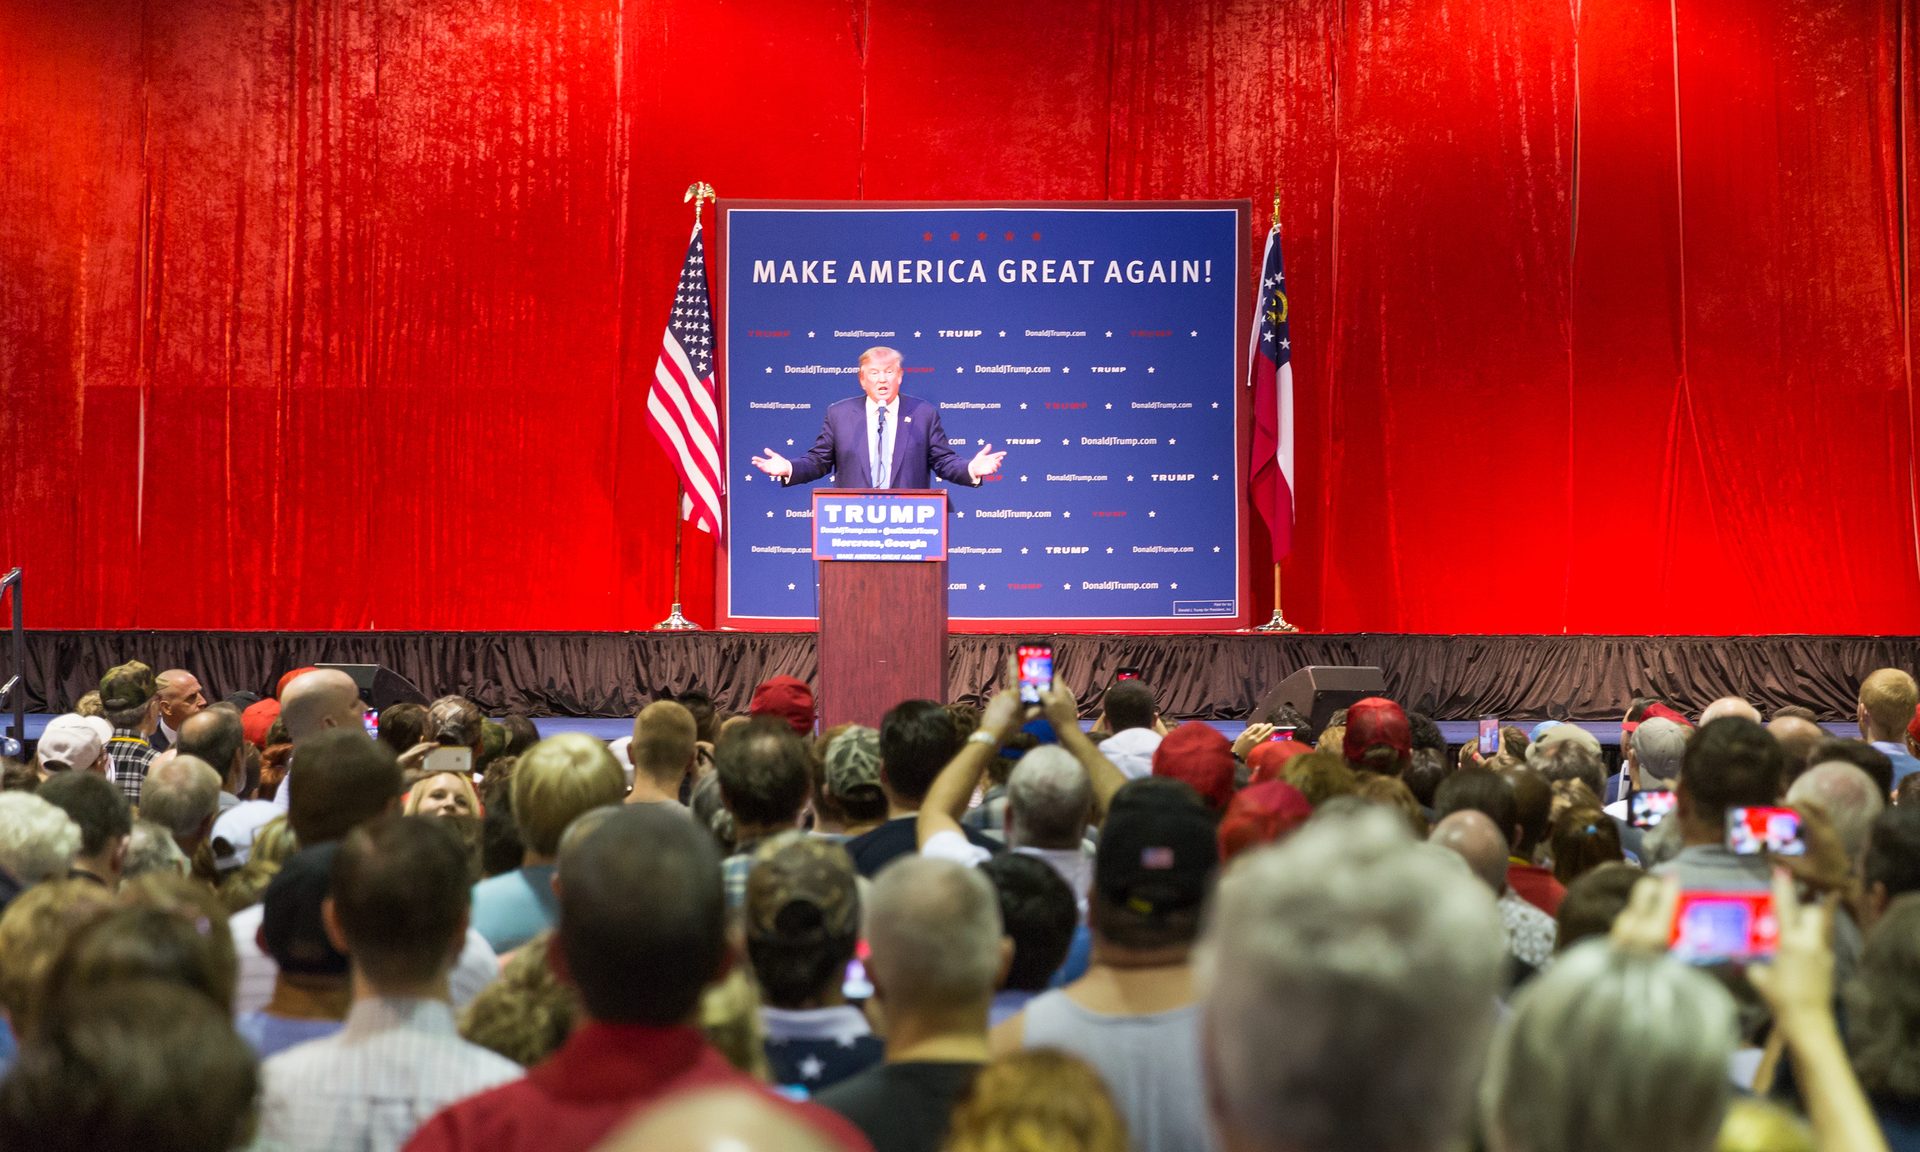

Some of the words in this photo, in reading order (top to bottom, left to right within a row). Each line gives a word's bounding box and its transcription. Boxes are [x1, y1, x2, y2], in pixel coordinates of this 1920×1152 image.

[753, 260, 836, 283] MAKE
[847, 260, 986, 283] AMERICA
[998, 260, 1094, 283] GREAT
[1104, 260, 1211, 283] AGAIN!
[834, 330, 895, 339] DonaldJTrump.com
[938, 330, 982, 338] TRUMP
[1025, 330, 1086, 338] DonaldJTrump.com
[785, 365, 859, 375] DonaldJTrump.com
[975, 365, 1051, 375] DonaldJTrump.com
[750, 402, 811, 410] DonaldJTrump.com
[940, 402, 1001, 410] DonaldJTrump.com
[1132, 402, 1193, 410] DonaldJTrump.com
[1081, 437, 1157, 447] DonaldJTrump.com
[1046, 474, 1108, 482] DonaldJTrump.com
[1151, 474, 1195, 482] TRUMP
[824, 505, 935, 524] TRUMP
[976, 510, 1052, 519] DonaldJTrump.com
[831, 538, 884, 549] Norcross,
[884, 538, 928, 550] Georgia
[751, 546, 811, 555] DonaldJTrump.com
[1045, 546, 1089, 554] TRUMP
[1132, 546, 1194, 554] DonaldJTrump.com
[1082, 581, 1159, 591] DonaldJTrump.com
